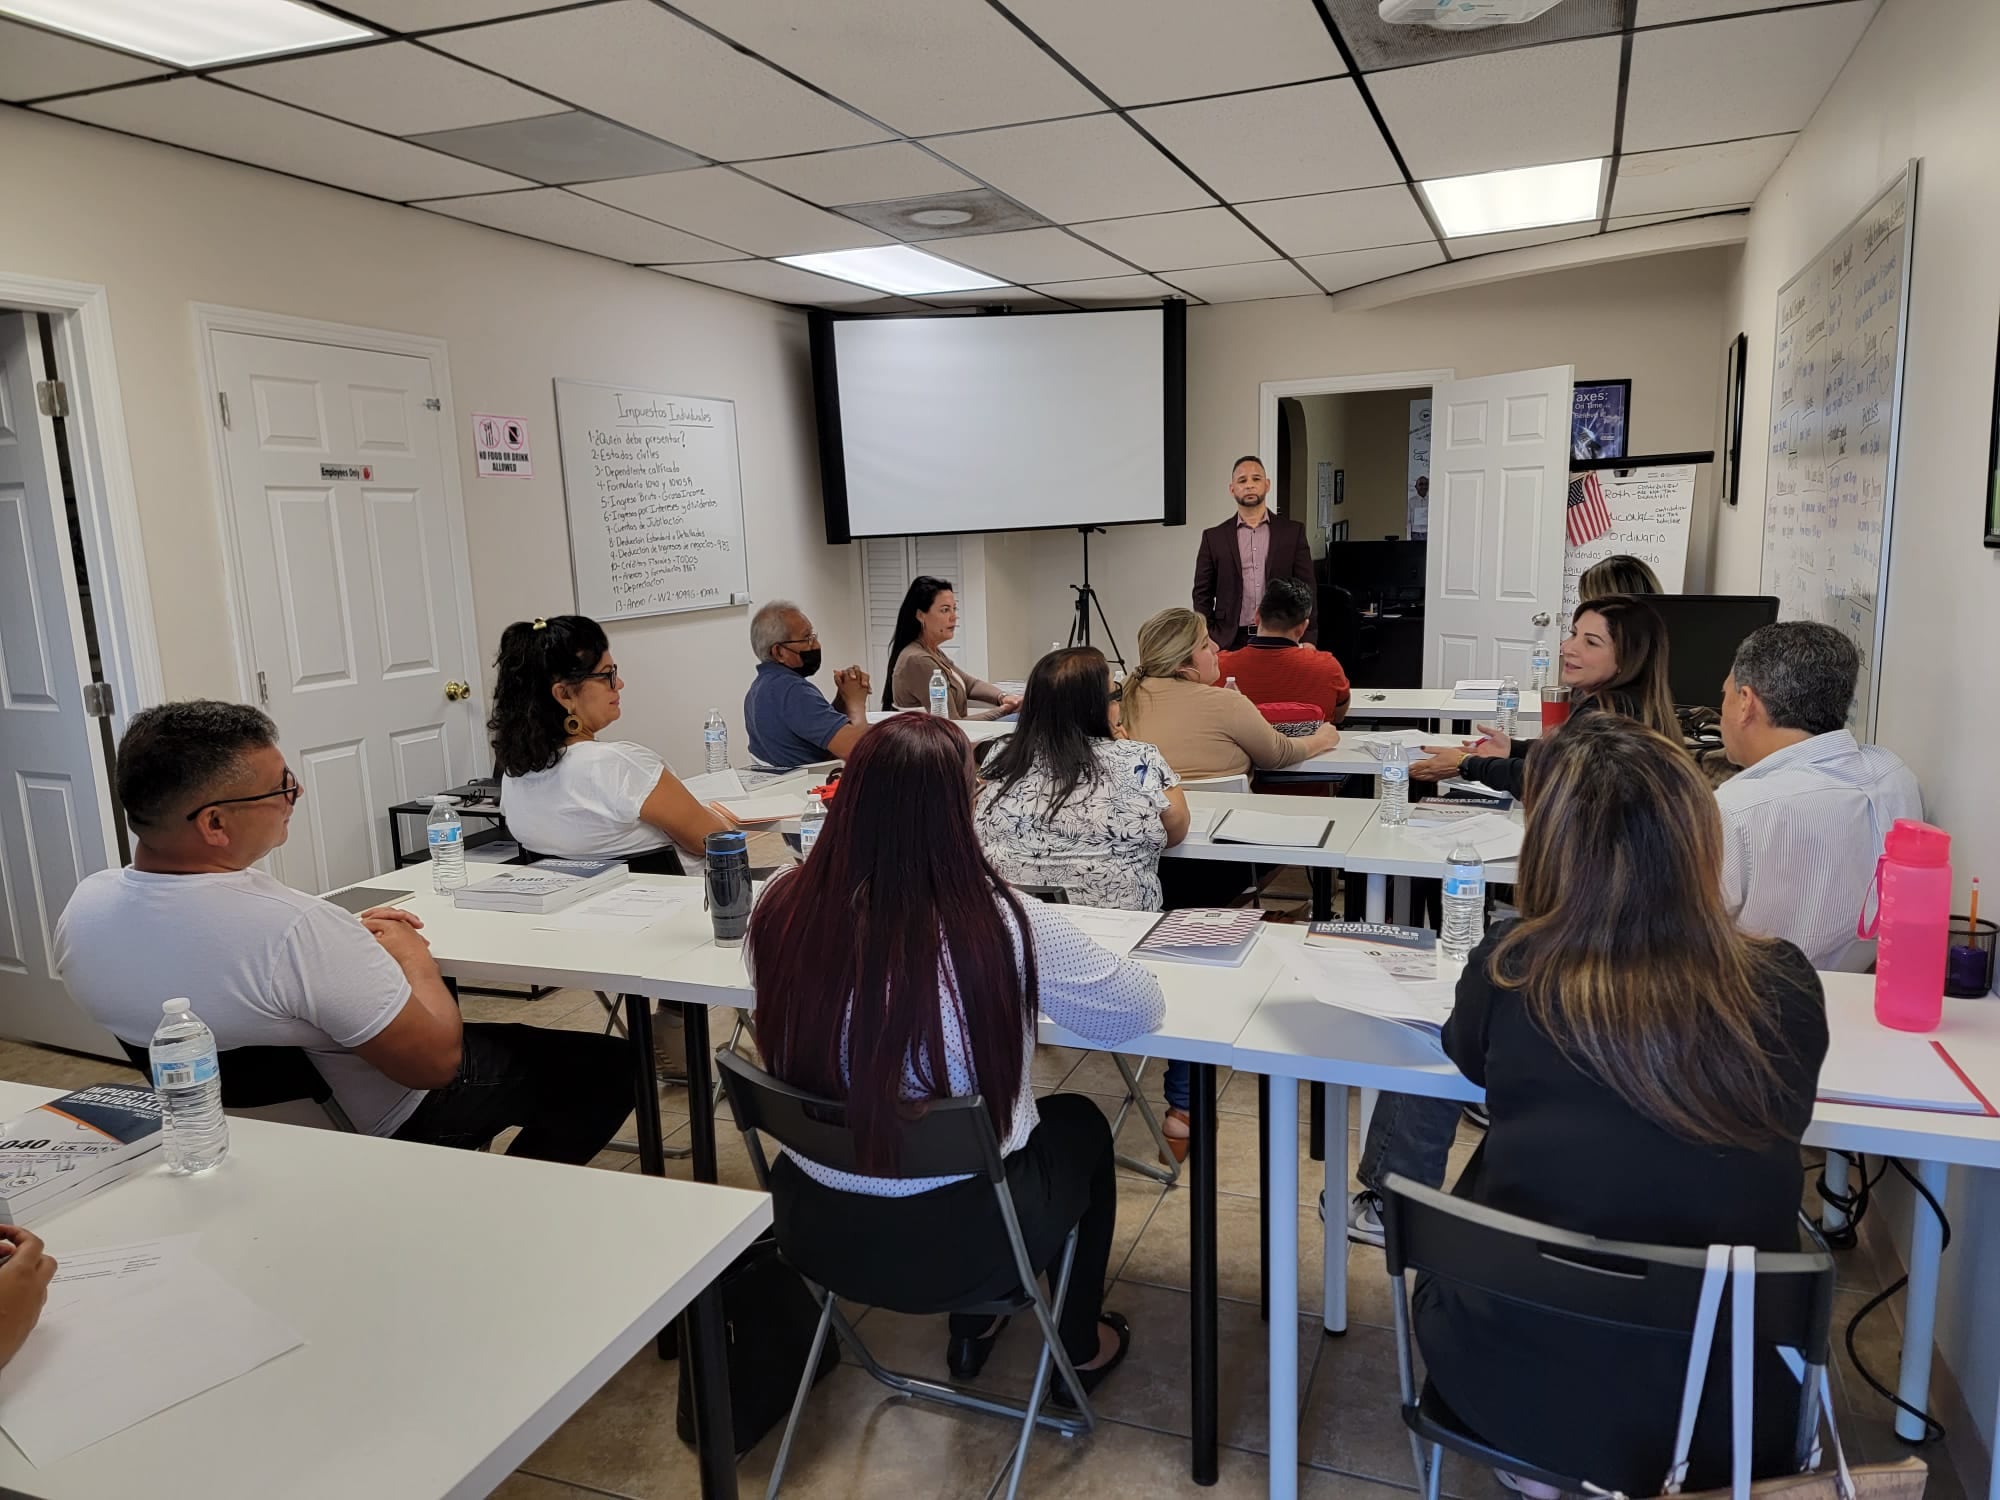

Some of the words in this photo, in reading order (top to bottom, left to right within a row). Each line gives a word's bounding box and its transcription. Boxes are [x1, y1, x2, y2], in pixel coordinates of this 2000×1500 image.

[1574, 391, 1609, 402] axes:
[613, 393, 667, 424] Impuestos
[479, 451, 487, 460] NO
[488, 451, 502, 461] FOOD
[503, 452, 511, 461] OR
[511, 453, 529, 462] DRINK
[492, 462, 517, 472] ALLOWED
[321, 467, 349, 479] Employees
[349, 467, 360, 480] Only
[1315, 926, 1420, 938] INDIVIDUALES
[1316, 923, 1400, 932] IMPUESTOS
[83, 1086, 158, 1102] IMPUESTO
[68, 1093, 162, 1112] INDIVIDUALE
[0, 1139, 51, 1150] 040
